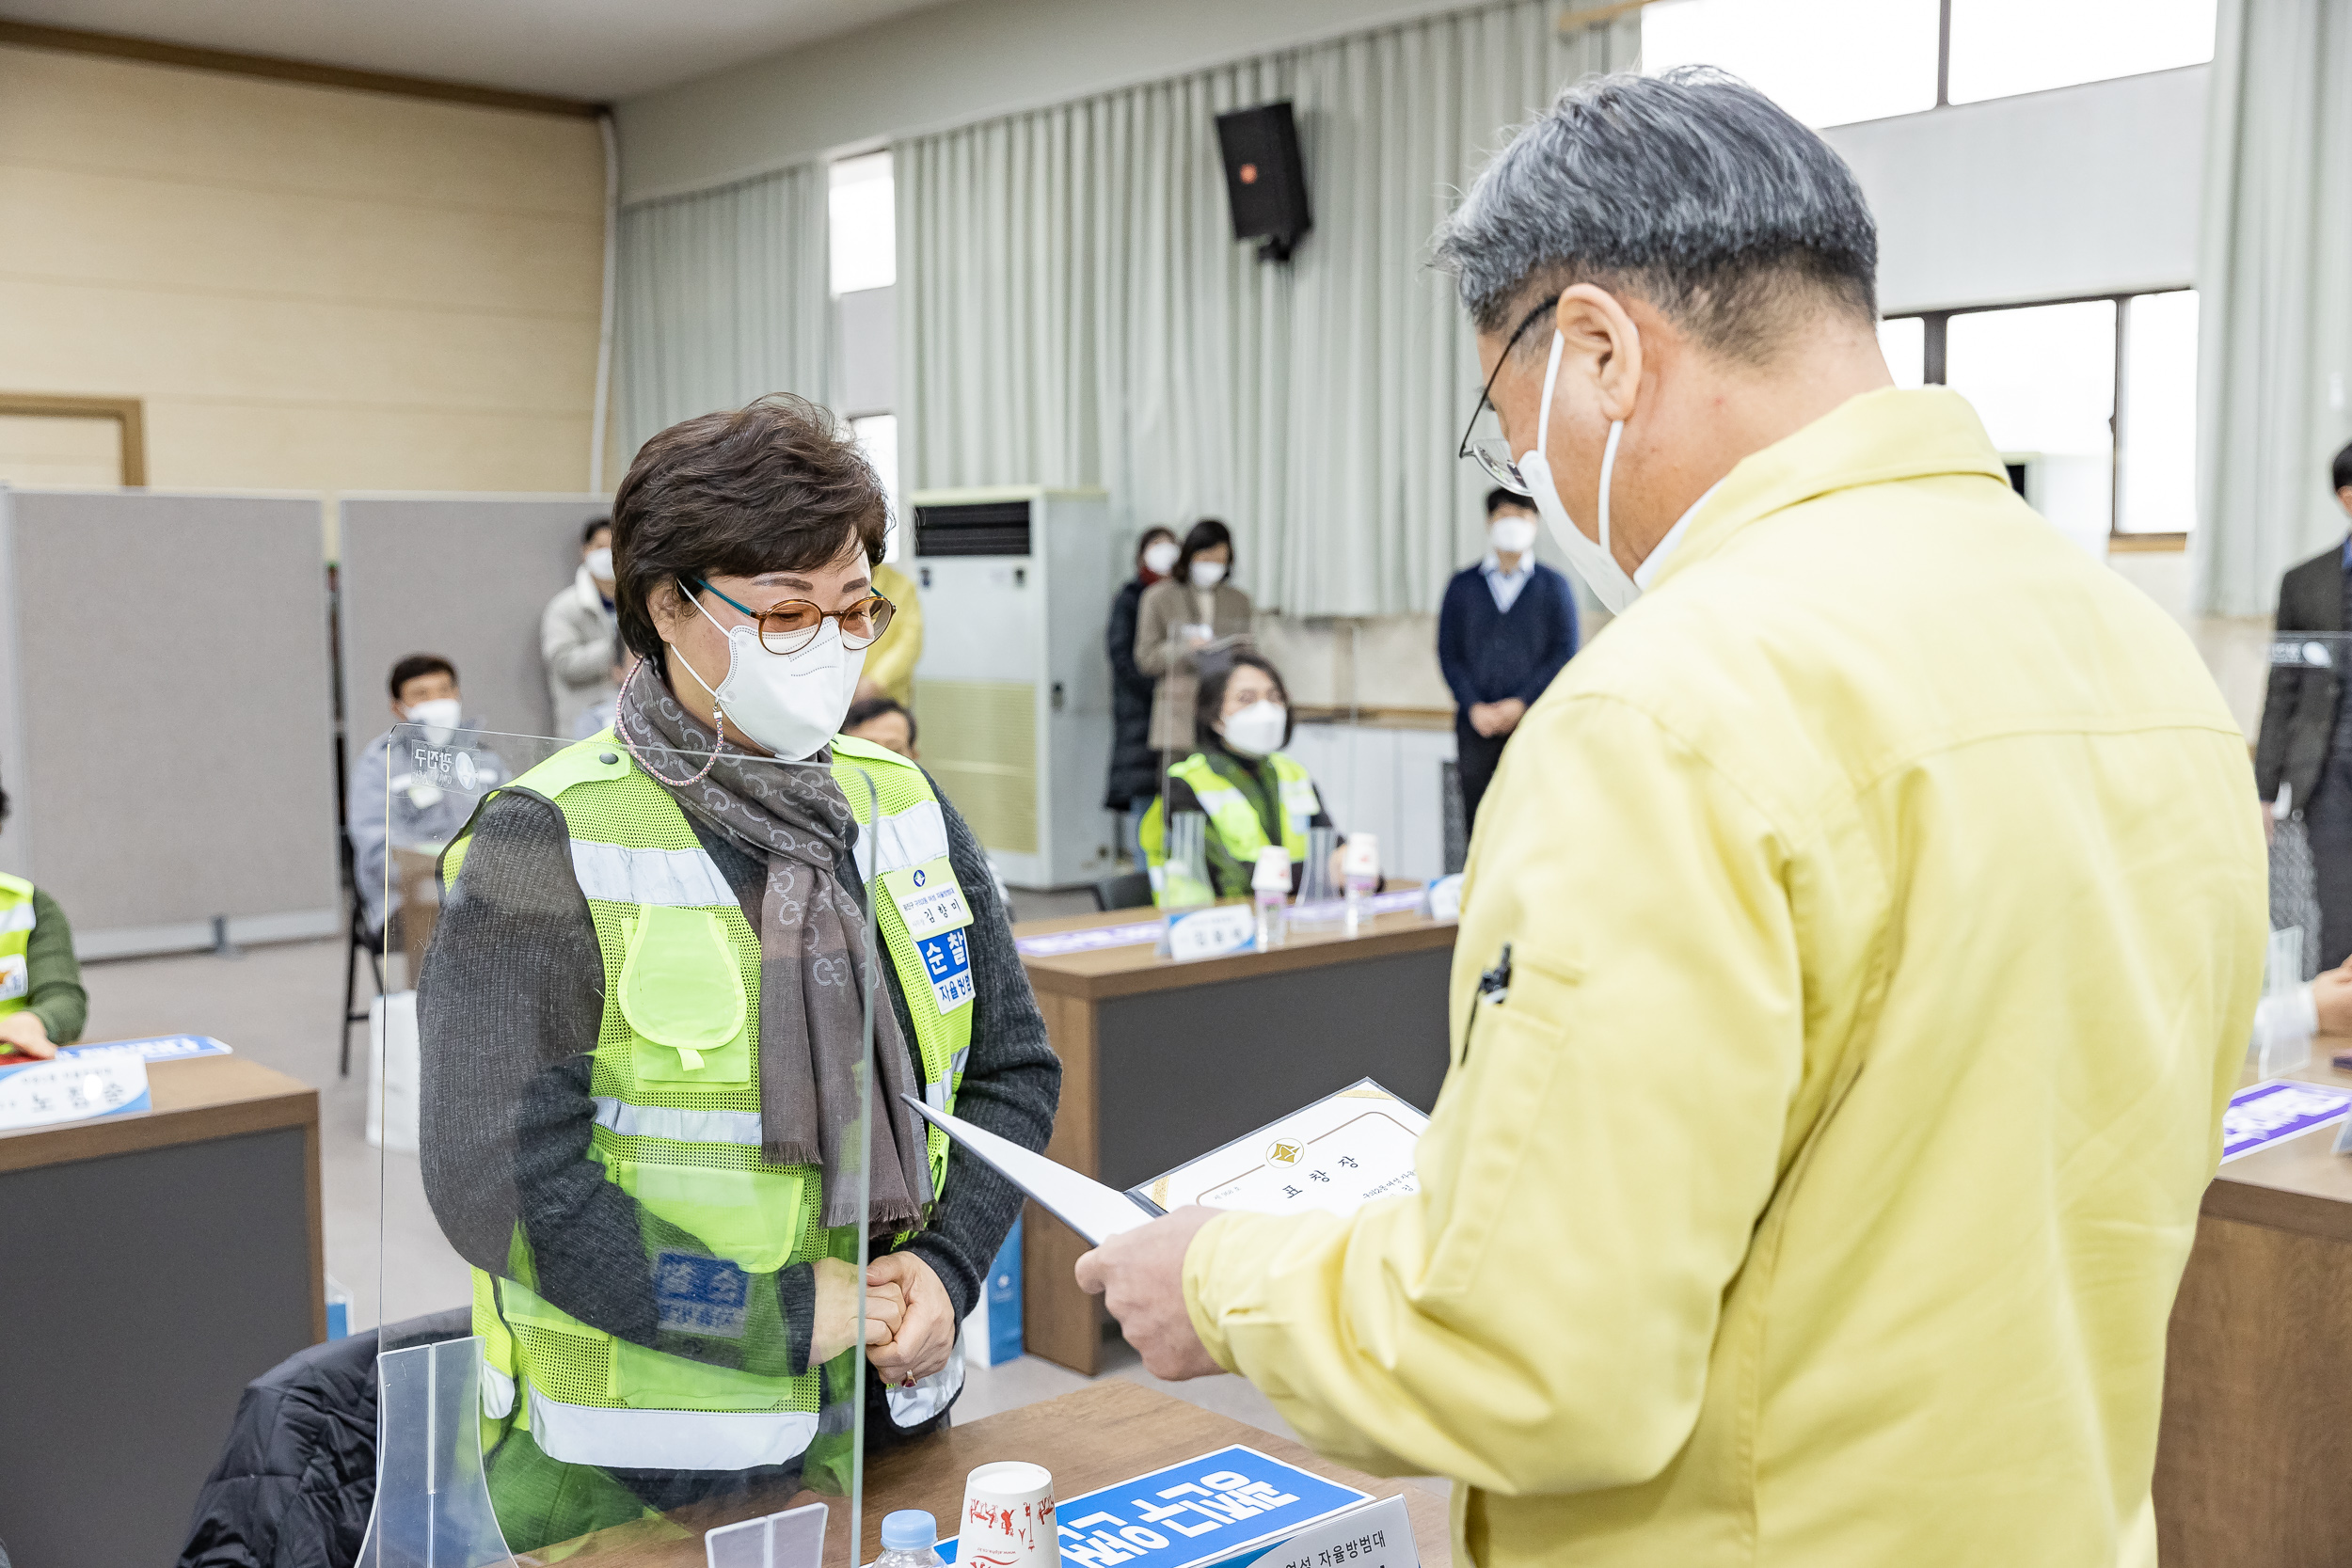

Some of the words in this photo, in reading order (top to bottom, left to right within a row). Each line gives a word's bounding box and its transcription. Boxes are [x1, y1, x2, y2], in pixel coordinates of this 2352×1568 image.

[927, 931, 965, 975] 순찰
[1131, 1470, 1301, 1538] 광진구
[1318, 1529, 1386, 1568] 자율방범대
